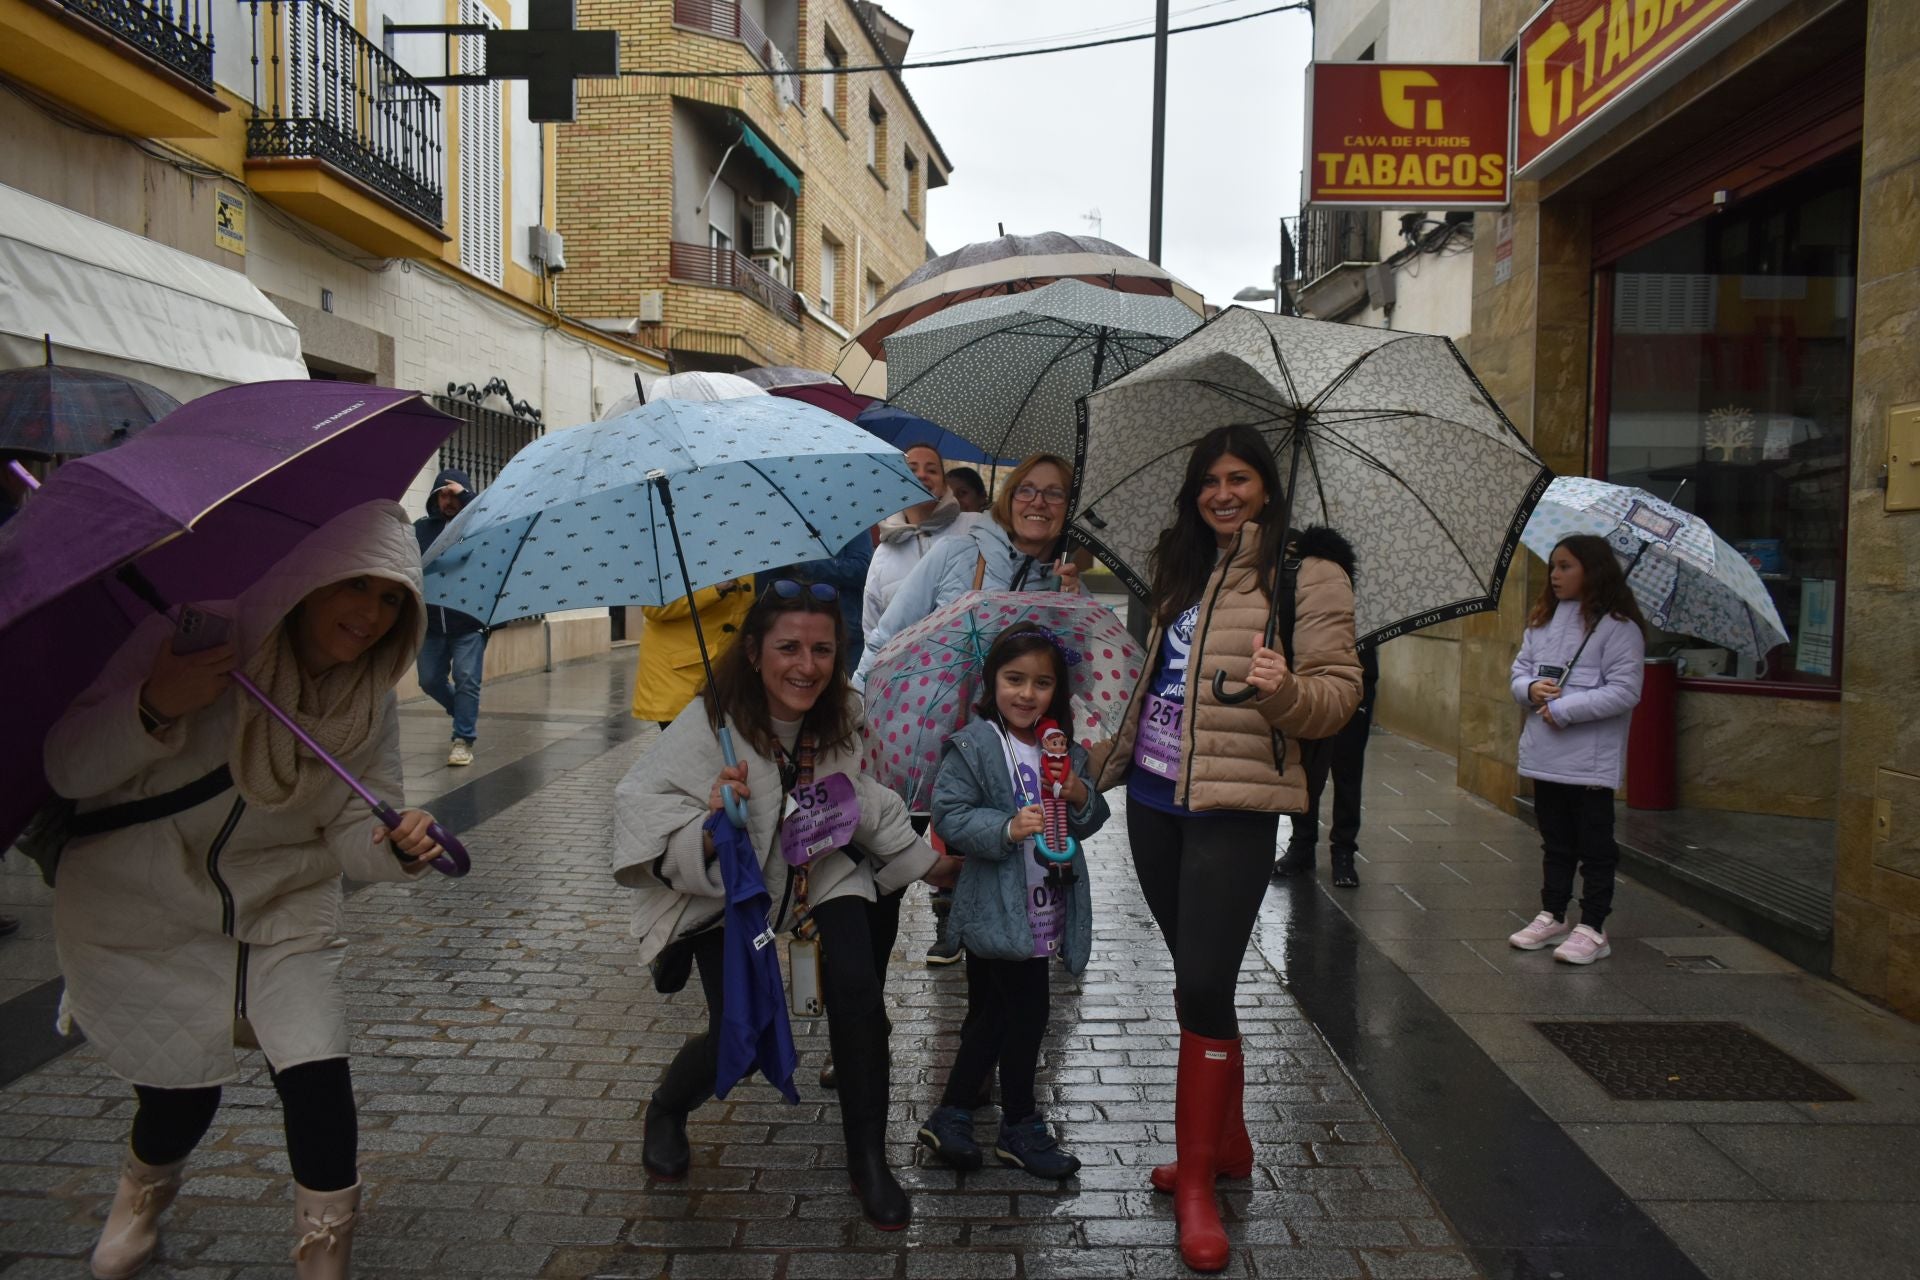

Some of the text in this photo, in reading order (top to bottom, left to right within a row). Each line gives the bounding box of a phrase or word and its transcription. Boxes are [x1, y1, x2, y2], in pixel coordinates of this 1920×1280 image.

[1344, 136, 1471, 147] CAVA DE PUROS
[1317, 153, 1504, 187] TABACOS
[1149, 700, 1184, 730] 251
